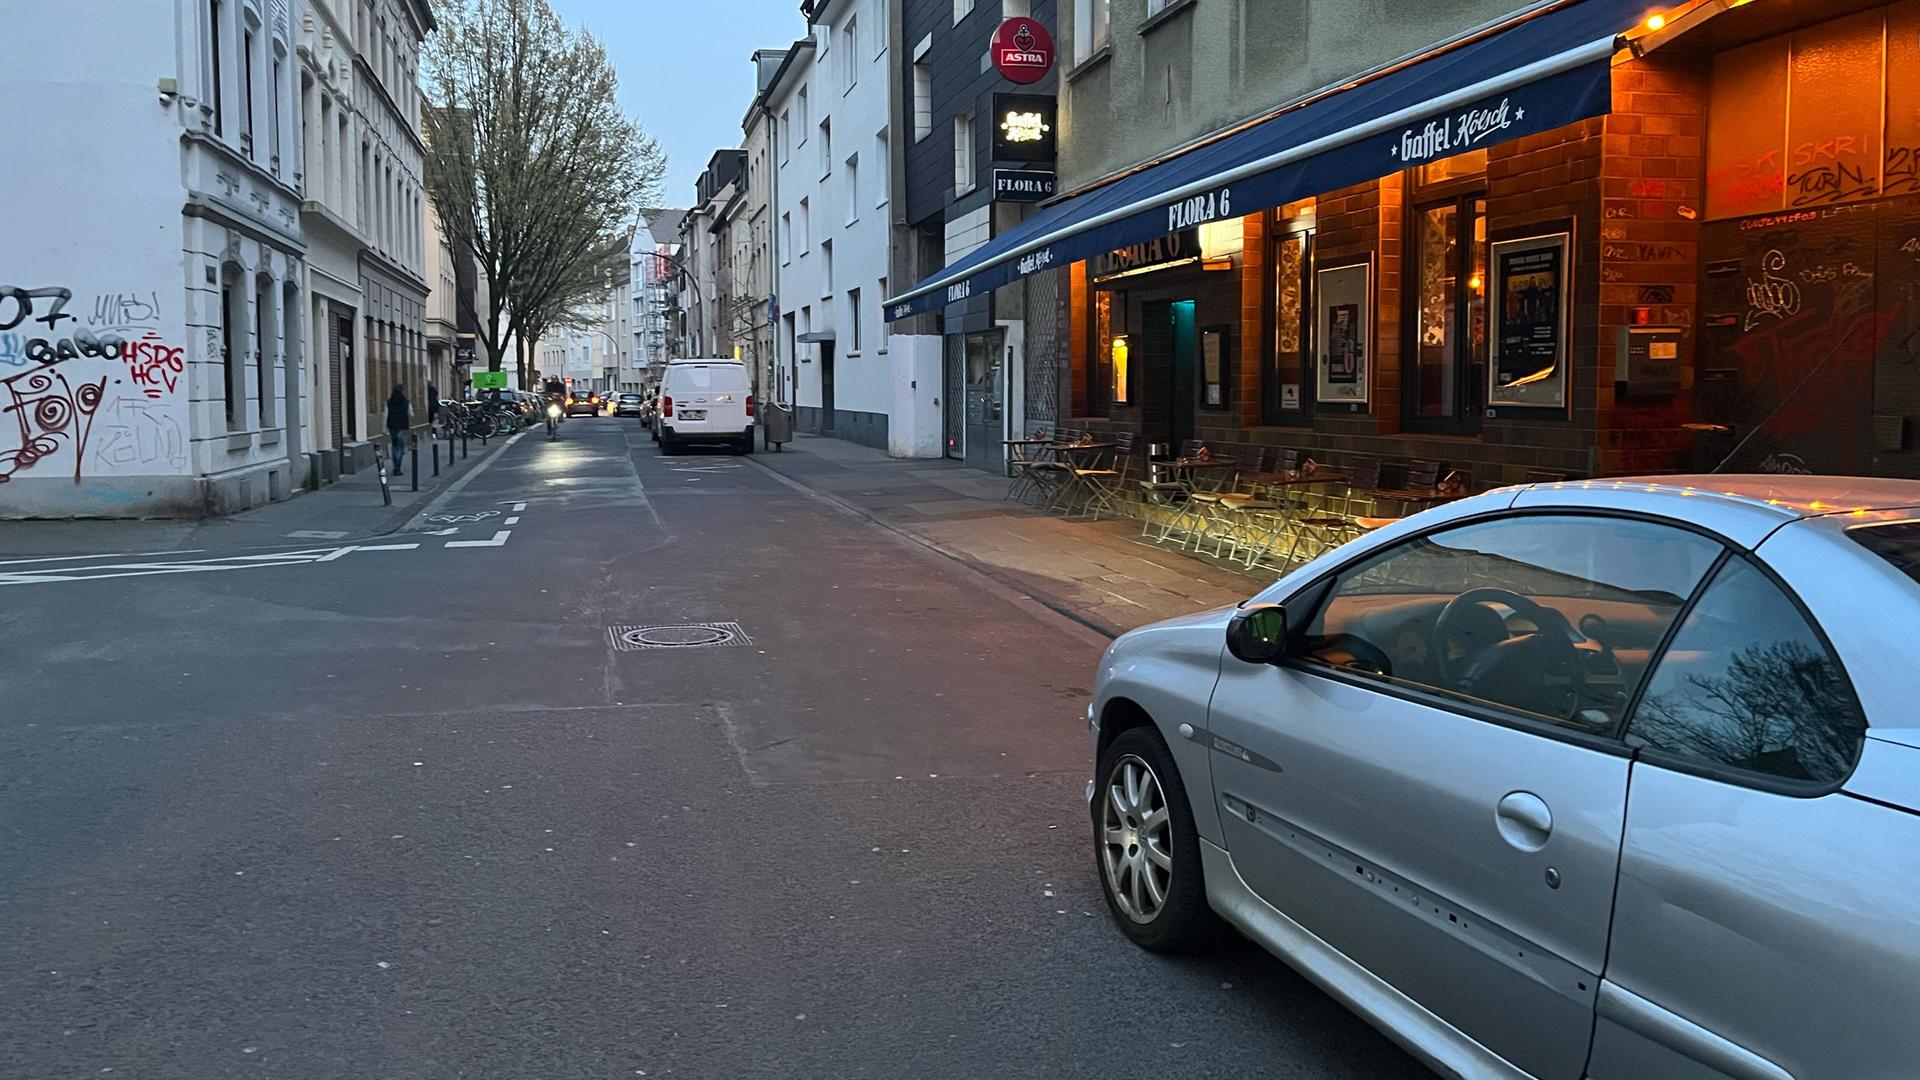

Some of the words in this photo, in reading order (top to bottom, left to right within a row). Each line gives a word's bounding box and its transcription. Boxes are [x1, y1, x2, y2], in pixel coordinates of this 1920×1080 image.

[1005, 52, 1043, 63] ASTRA
[1401, 117, 1450, 161] Gaffel
[1453, 98, 1511, 146] Kölsch
[997, 179, 1042, 192] FLORA
[1045, 182, 1052, 192] 6
[1168, 192, 1215, 231] FLORA
[1220, 188, 1230, 216] 6
[130, 365, 177, 394] HCV
